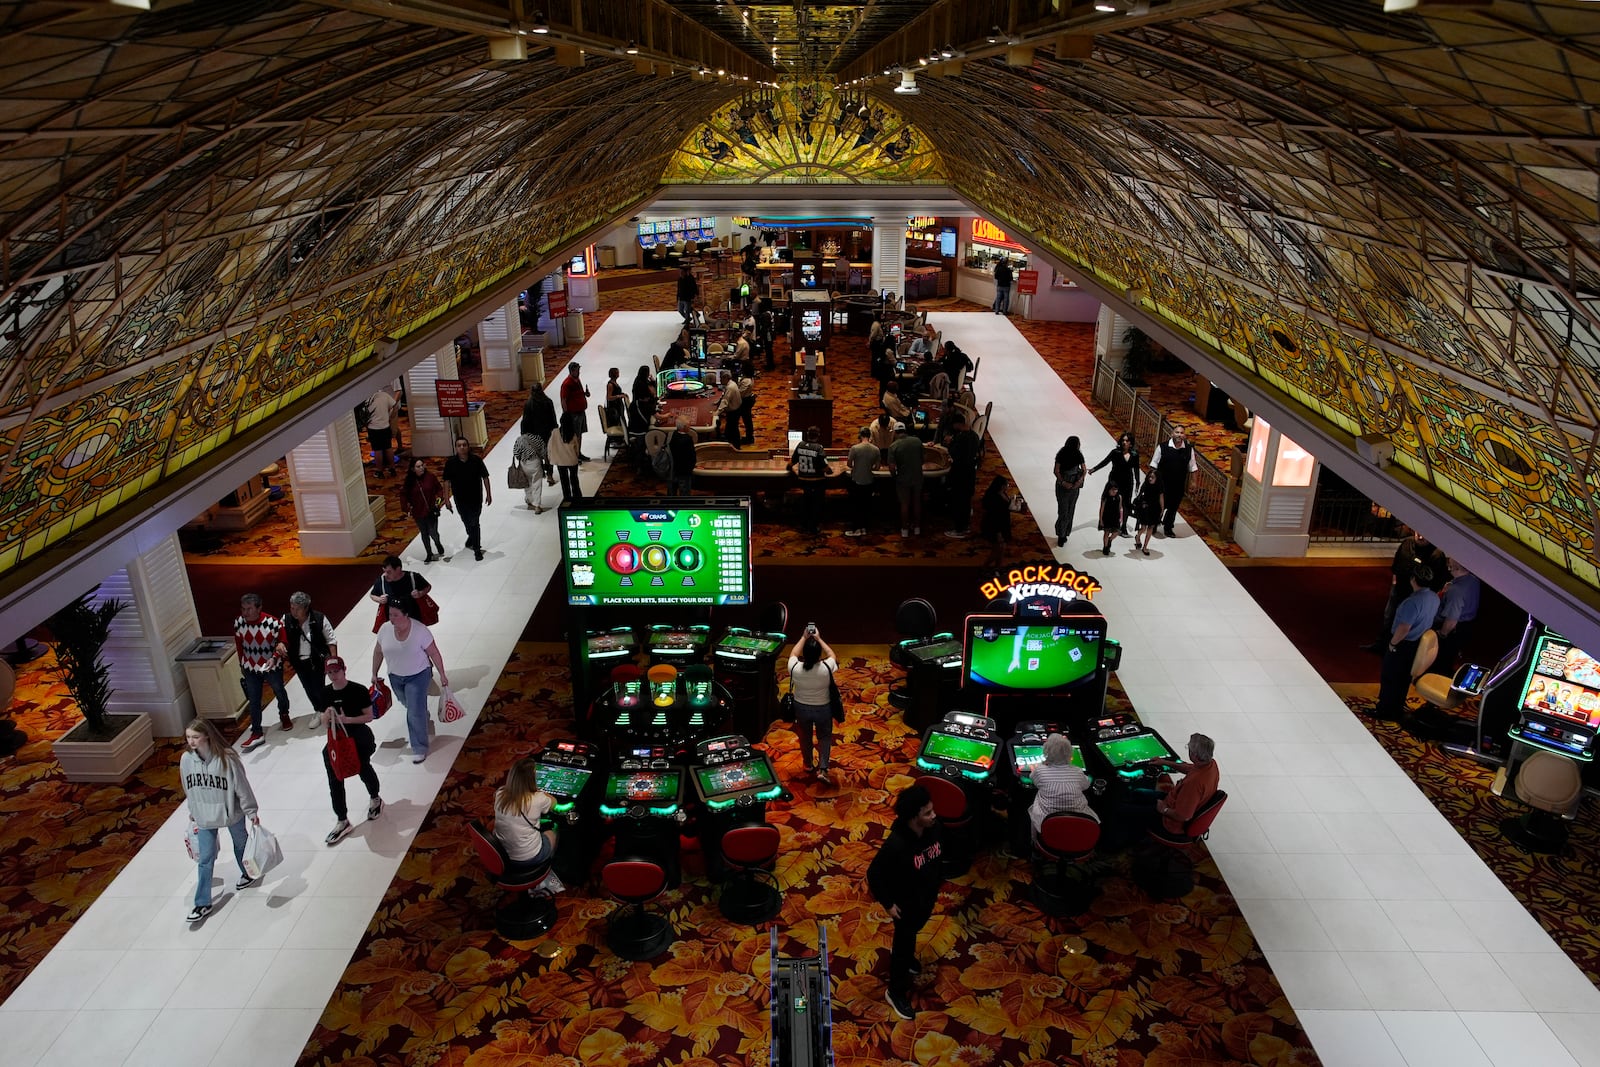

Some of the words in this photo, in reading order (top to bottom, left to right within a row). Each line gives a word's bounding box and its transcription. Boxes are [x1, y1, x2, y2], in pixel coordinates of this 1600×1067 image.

[798, 455, 816, 474] 81
[689, 517, 698, 525] 11
[980, 565, 1102, 600] BLACKJACK
[1007, 582, 1077, 604] Xtreme
[186, 773, 228, 791] HARVARD
